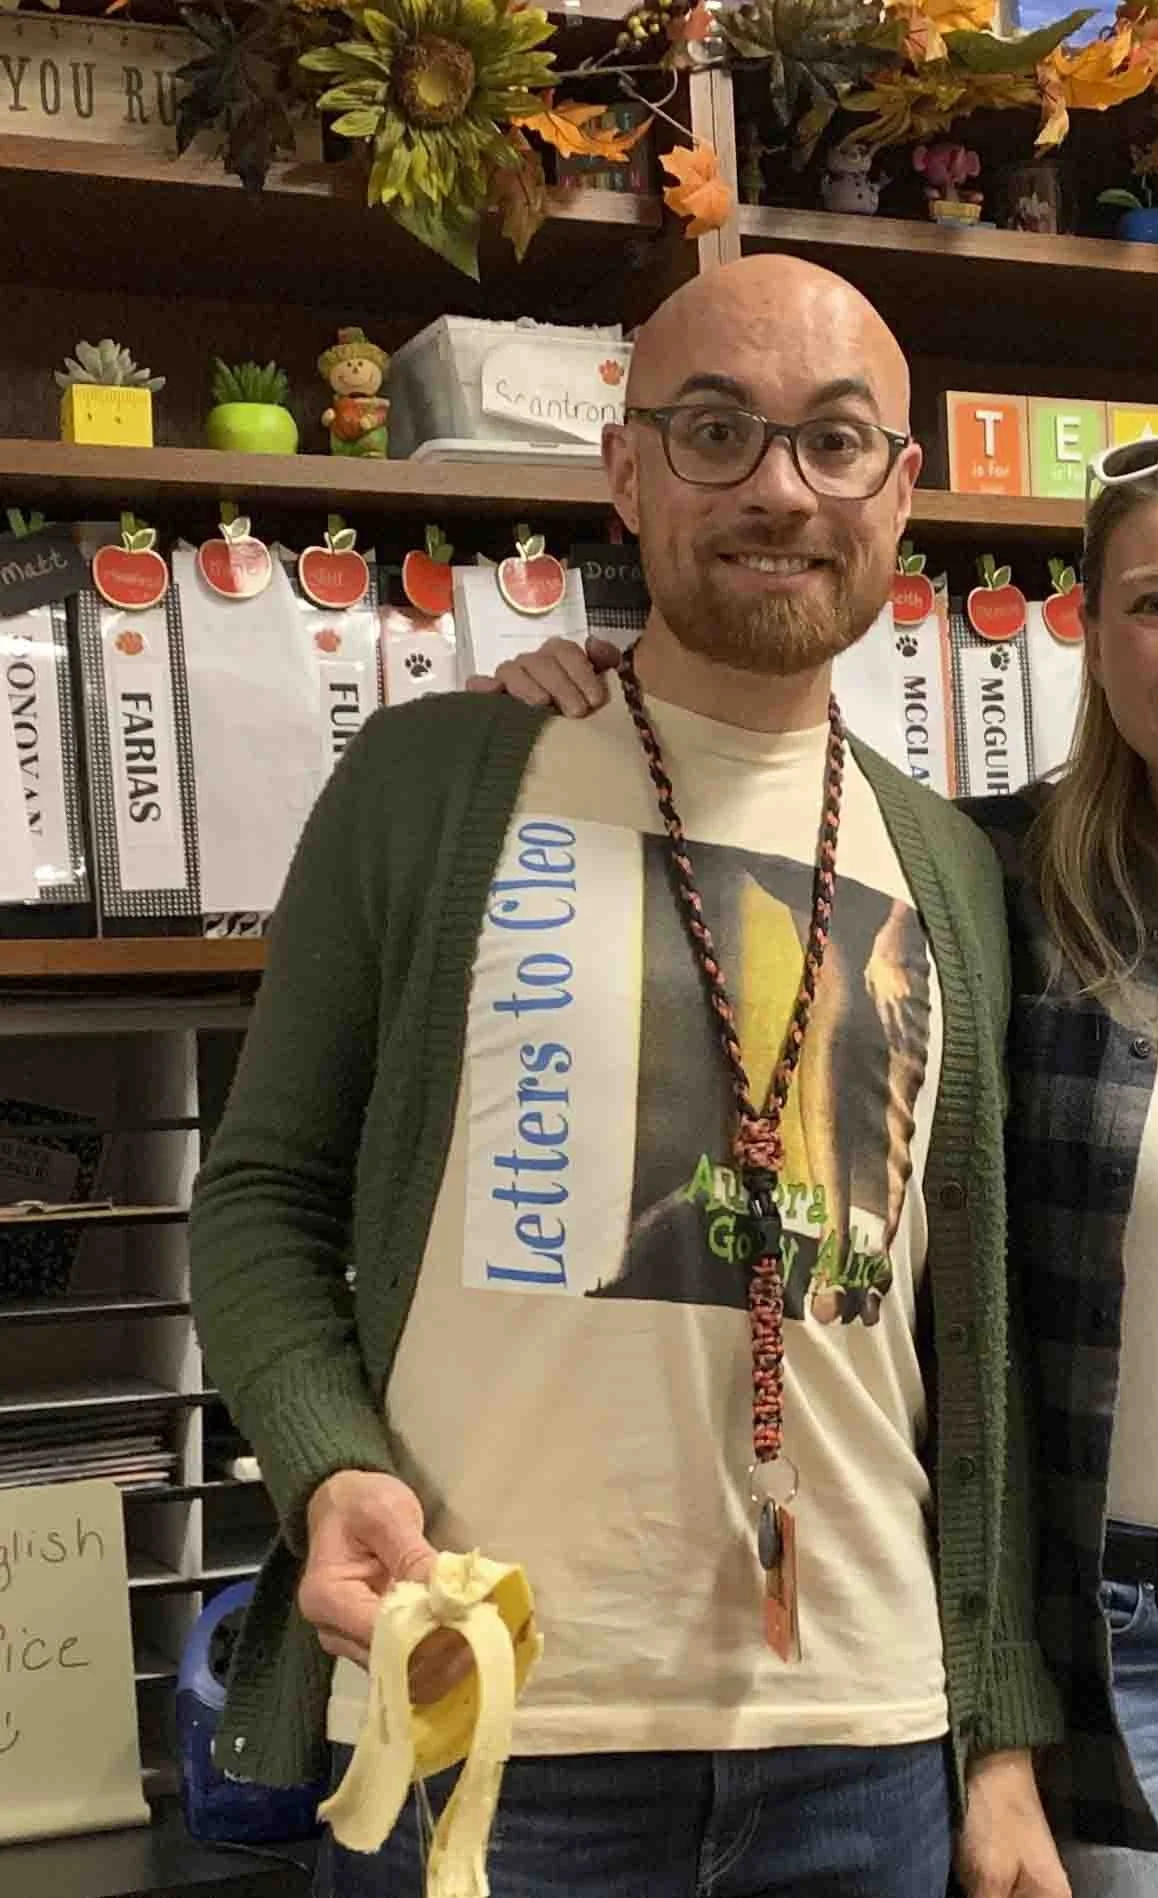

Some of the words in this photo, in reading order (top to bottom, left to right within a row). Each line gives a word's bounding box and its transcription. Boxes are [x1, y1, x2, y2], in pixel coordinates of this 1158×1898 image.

[1, 55, 96, 119] YOU
[121, 692, 161, 823] FARIAS
[487, 821, 577, 930] Cleo
[493, 952, 574, 1019] to
[486, 1042, 573, 1289] Letters
[708, 1213, 800, 1290] Goy
